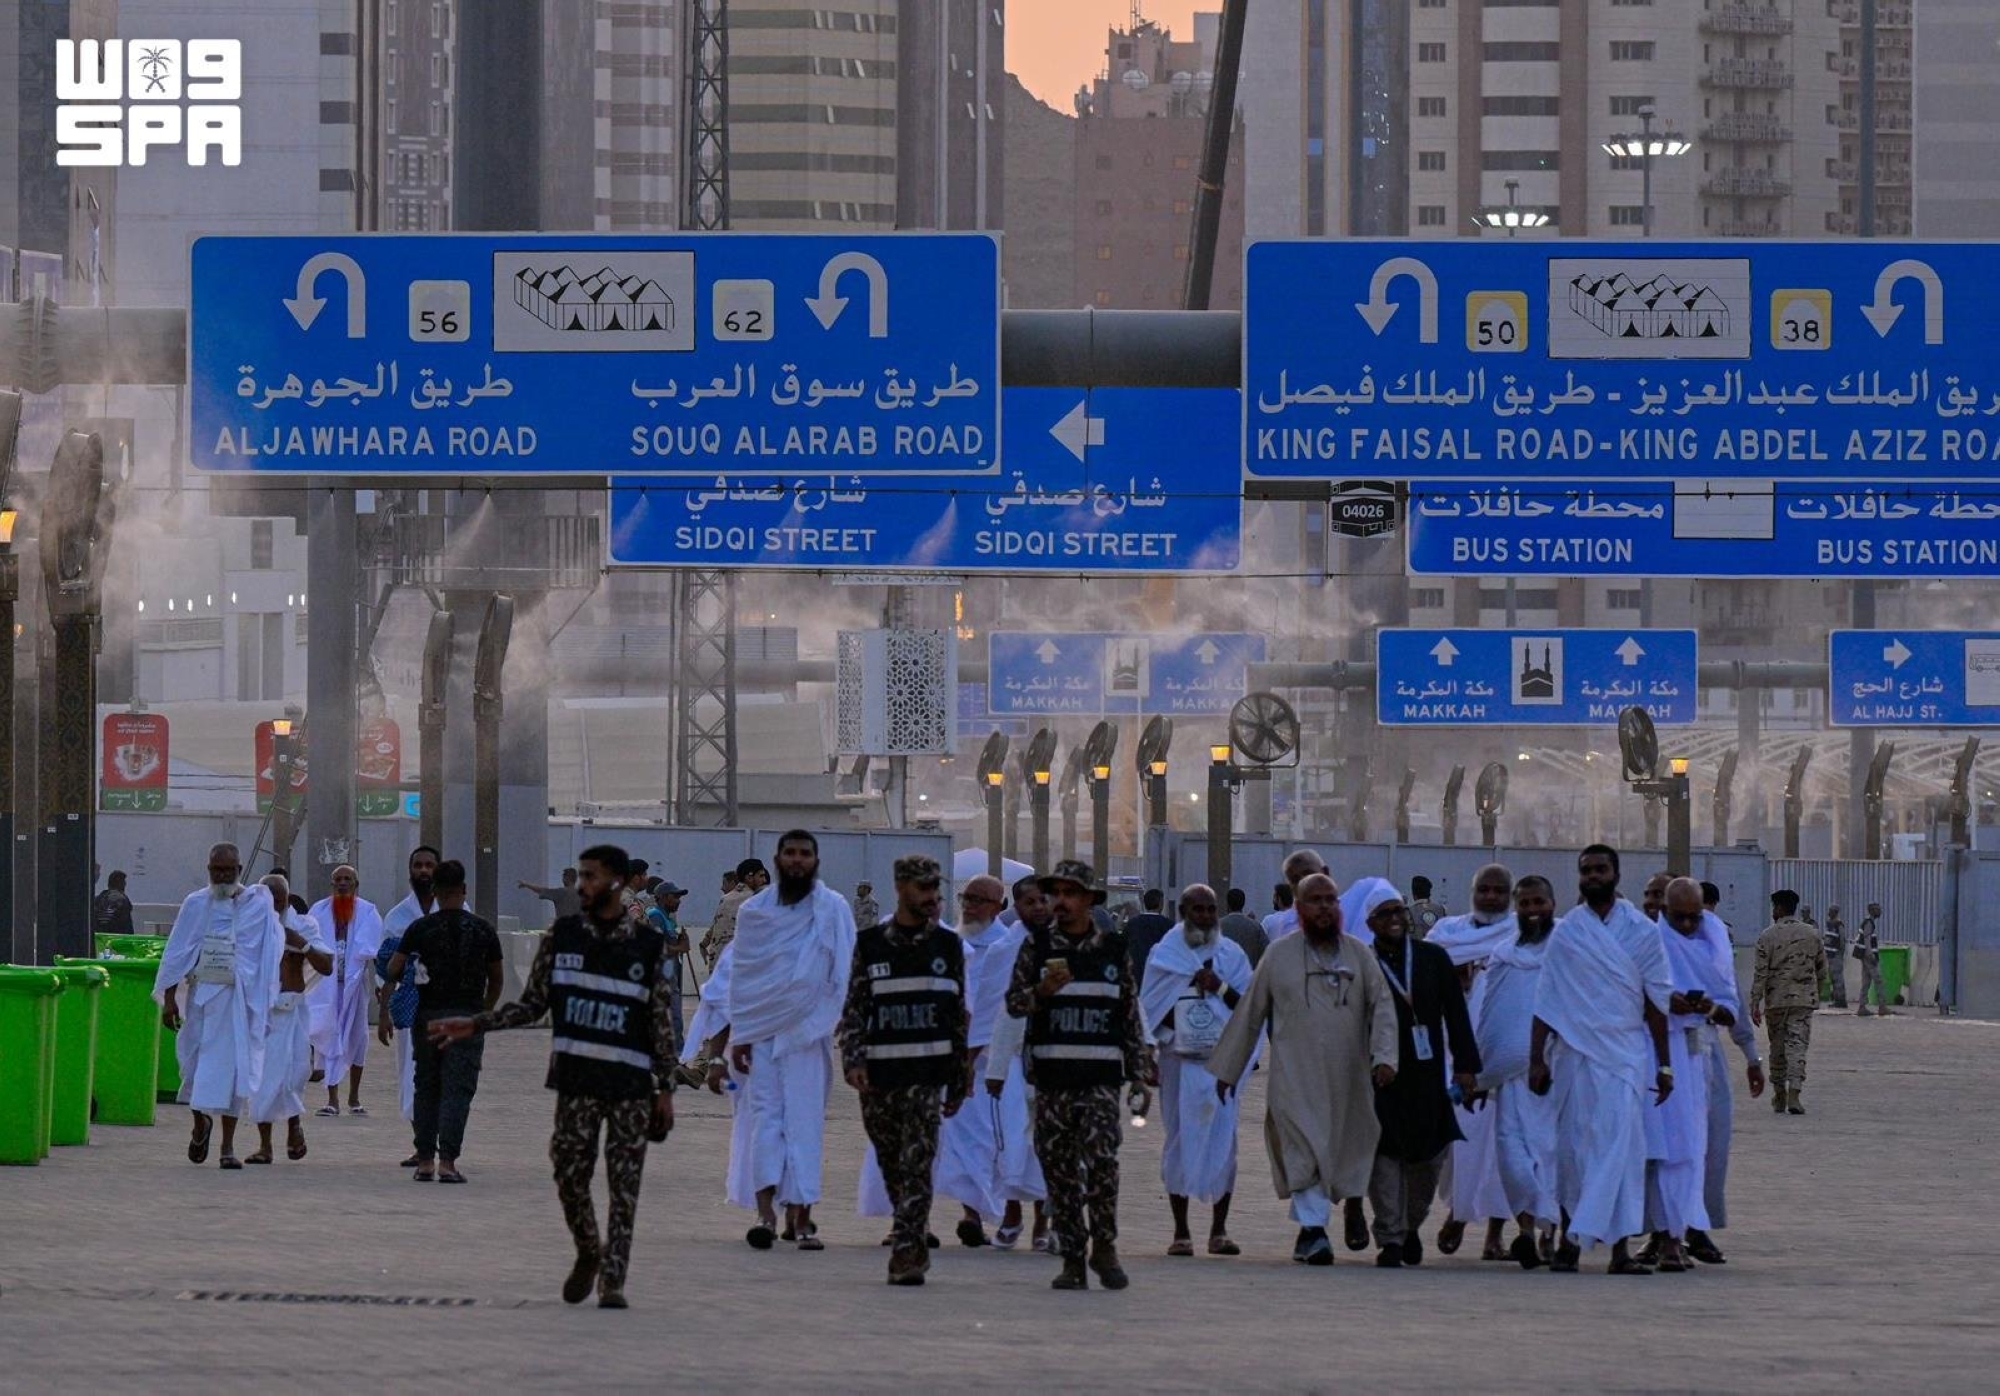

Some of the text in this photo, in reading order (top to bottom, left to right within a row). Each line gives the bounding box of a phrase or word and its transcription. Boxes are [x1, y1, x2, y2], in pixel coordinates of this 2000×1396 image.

[420, 311, 458, 334] 56
[725, 310, 763, 333] 62
[1478, 320, 1514, 345] 50
[1784, 319, 1820, 343] 38
[237, 359, 513, 410] طريق الجوهرة
[631, 362, 979, 409] طريق سوق العرب
[1258, 364, 1375, 415] فيصل
[1383, 366, 1484, 407] الملك
[1493, 370, 1595, 416] طريق
[1826, 368, 1928, 408] الملك
[1936, 375, 2000, 417] ريق
[449, 426, 537, 455] ROAD
[632, 423, 983, 455] SOUQ ALARAB ROAD
[1258, 428, 1335, 459] KING
[1351, 428, 1481, 459] FAISAL
[1714, 428, 1828, 460] ABDEL
[1844, 428, 1927, 461] AZIZ
[1942, 428, 2000, 461] RO
[793, 474, 867, 513] شارع
[985, 470, 1166, 525] شارع صدقي
[1419, 485, 1664, 520] محطة حافلات
[1787, 488, 2000, 519] حطة حافلات
[1342, 503, 1385, 519] 04026
[675, 527, 877, 551] SIDQI STREET
[974, 531, 1177, 556] SIDQI STREET
[1453, 538, 1632, 563] BUS STATION
[1818, 540, 1998, 564] BUS STATION
[1397, 680, 1494, 699] مكة المكرمة
[1581, 680, 1678, 699] مكة المكرمة
[1853, 676, 1944, 700] شارع الحج
[1012, 697, 1082, 709] MAKKAH
[1172, 697, 1235, 709] MAKKA
[1404, 704, 1485, 718] MAKKAH
[1589, 704, 1671, 718] MAAH
[1853, 705, 1943, 718] AL HAJJ ST.
[878, 1003, 939, 1030] POLICE
[1049, 1007, 1111, 1034] POLICE
